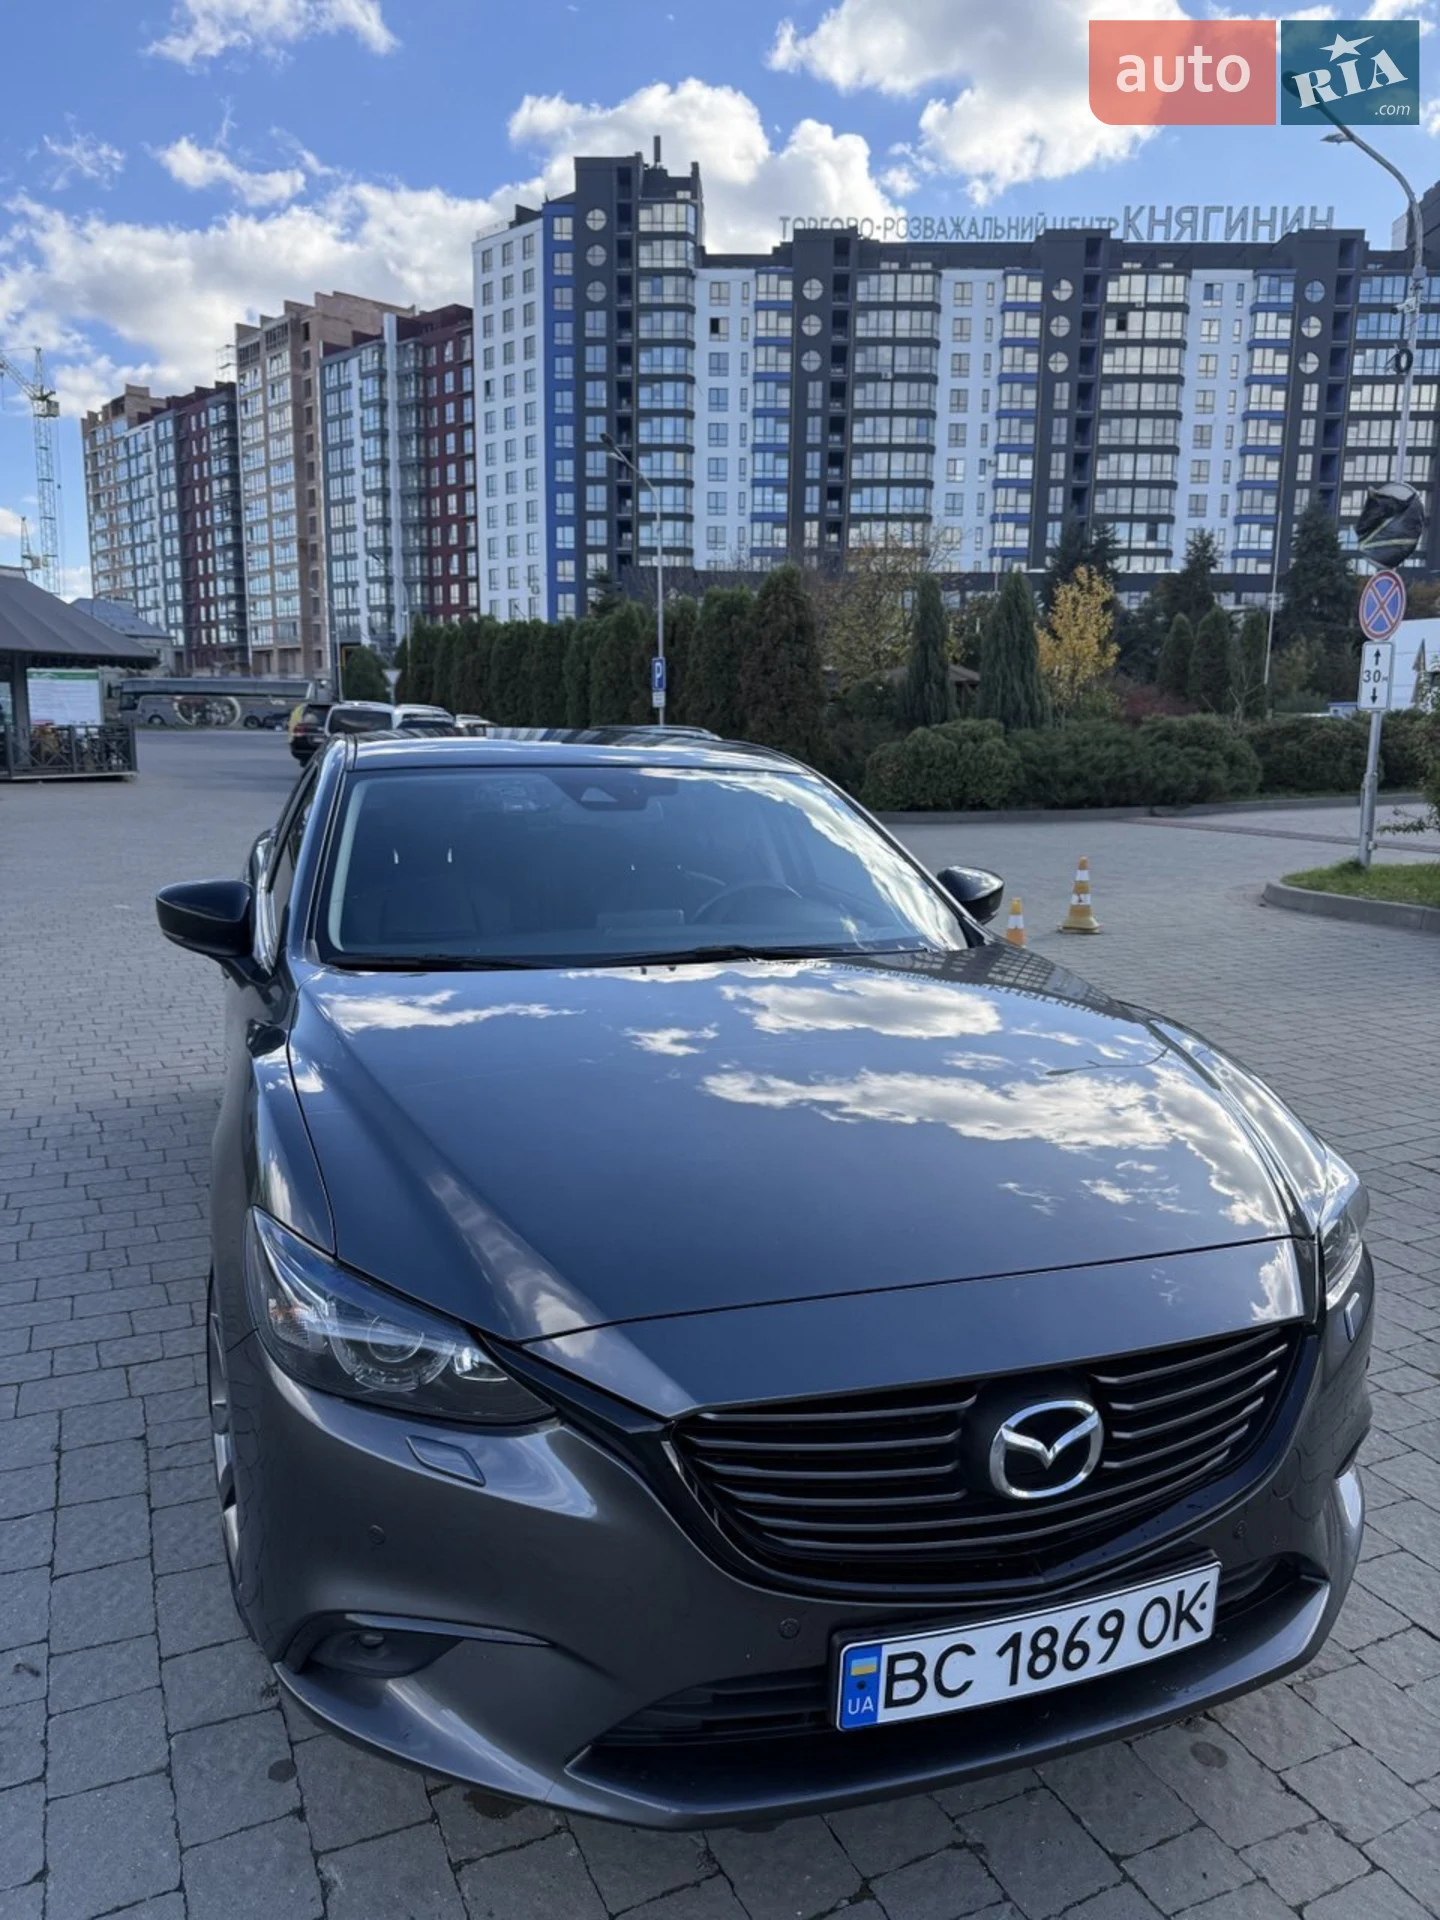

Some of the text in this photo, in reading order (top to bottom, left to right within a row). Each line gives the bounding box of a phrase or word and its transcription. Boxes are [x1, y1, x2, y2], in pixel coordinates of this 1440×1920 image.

[1122, 205, 1335, 241] КНЯГИНИН
[884, 1581, 1211, 1709] BC 1869 OK
[847, 1695, 875, 1715] UA
